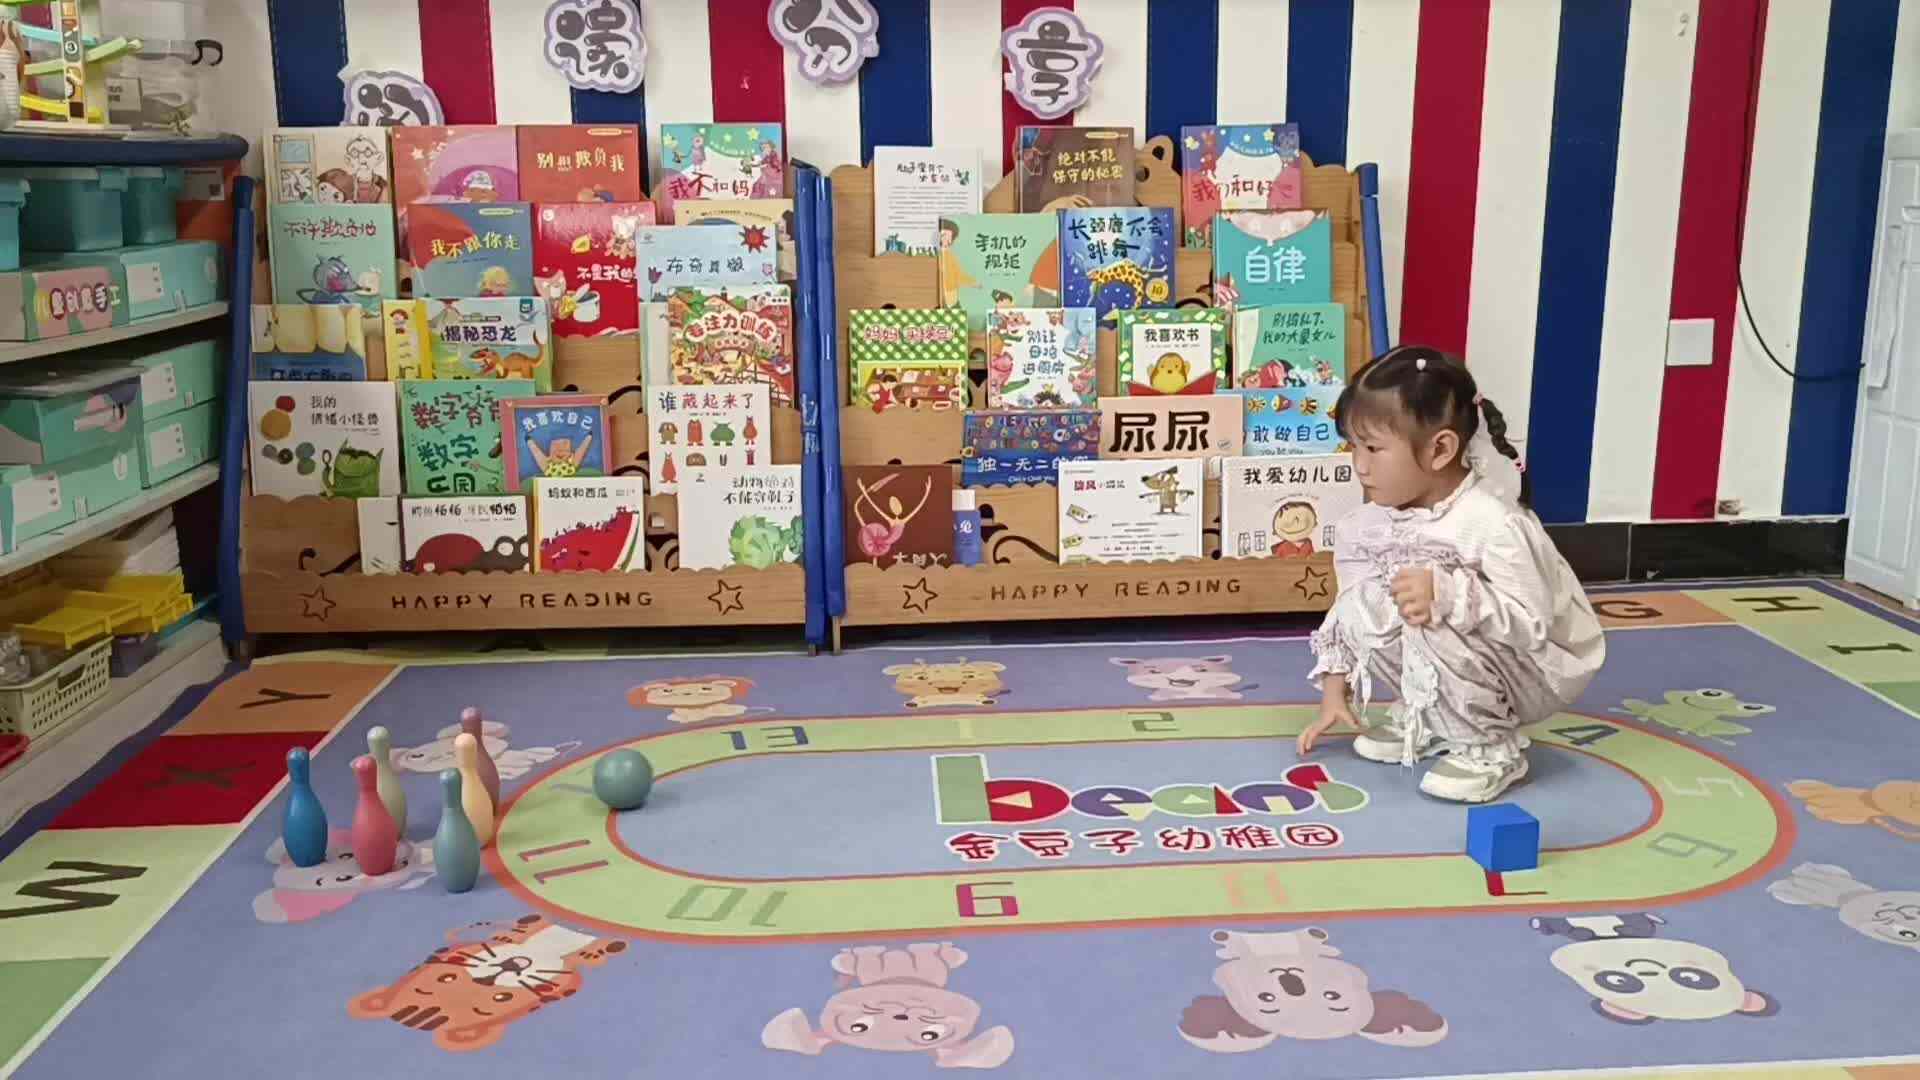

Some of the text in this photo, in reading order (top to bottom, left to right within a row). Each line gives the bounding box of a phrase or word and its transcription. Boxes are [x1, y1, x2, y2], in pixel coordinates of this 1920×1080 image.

[555, 0, 632, 78] 读
[1016, 20, 1088, 105] 享
[537, 146, 625, 173] 别想欺负我
[1057, 148, 1117, 166] 绝对不能
[1068, 213, 1163, 240] 长颈鹿不会
[431, 231, 521, 258] 我不跟你走
[975, 233, 1027, 253] 手机的
[1088, 238, 1141, 264] 跳舞
[984, 253, 1021, 270] 规矩
[1245, 245, 1307, 285] 自律
[576, 263, 636, 283] 不是我的
[444, 325, 517, 342] 揭秘恐龙
[687, 313, 772, 340] 专注力训练
[1027, 329, 1056, 343] 别让
[1144, 328, 1200, 342] 我喜欢书
[311, 395, 337, 409] 我的
[659, 391, 754, 413] 谁藏起来了
[311, 412, 379, 426] 情绪小怪兽
[522, 410, 593, 432] 我喜欢自己
[1109, 411, 1210, 452] 尿尿
[1253, 423, 1330, 443] 敢做自己
[417, 434, 479, 471] 数字
[1244, 465, 1351, 485] 我爱幼儿园
[547, 486, 608, 499] 蚂蚁和西瓜
[991, 578, 1242, 601] HAPPY READING
[391, 592, 653, 610] HAPPY READING
[1731, 595, 1823, 614] H
[238, 687, 332, 710] Y
[1549, 723, 1620, 747] 4
[143, 761, 258, 789] X
[948, 824, 1343, 861] 金豆子幼稚园
[0, 861, 149, 920] W
